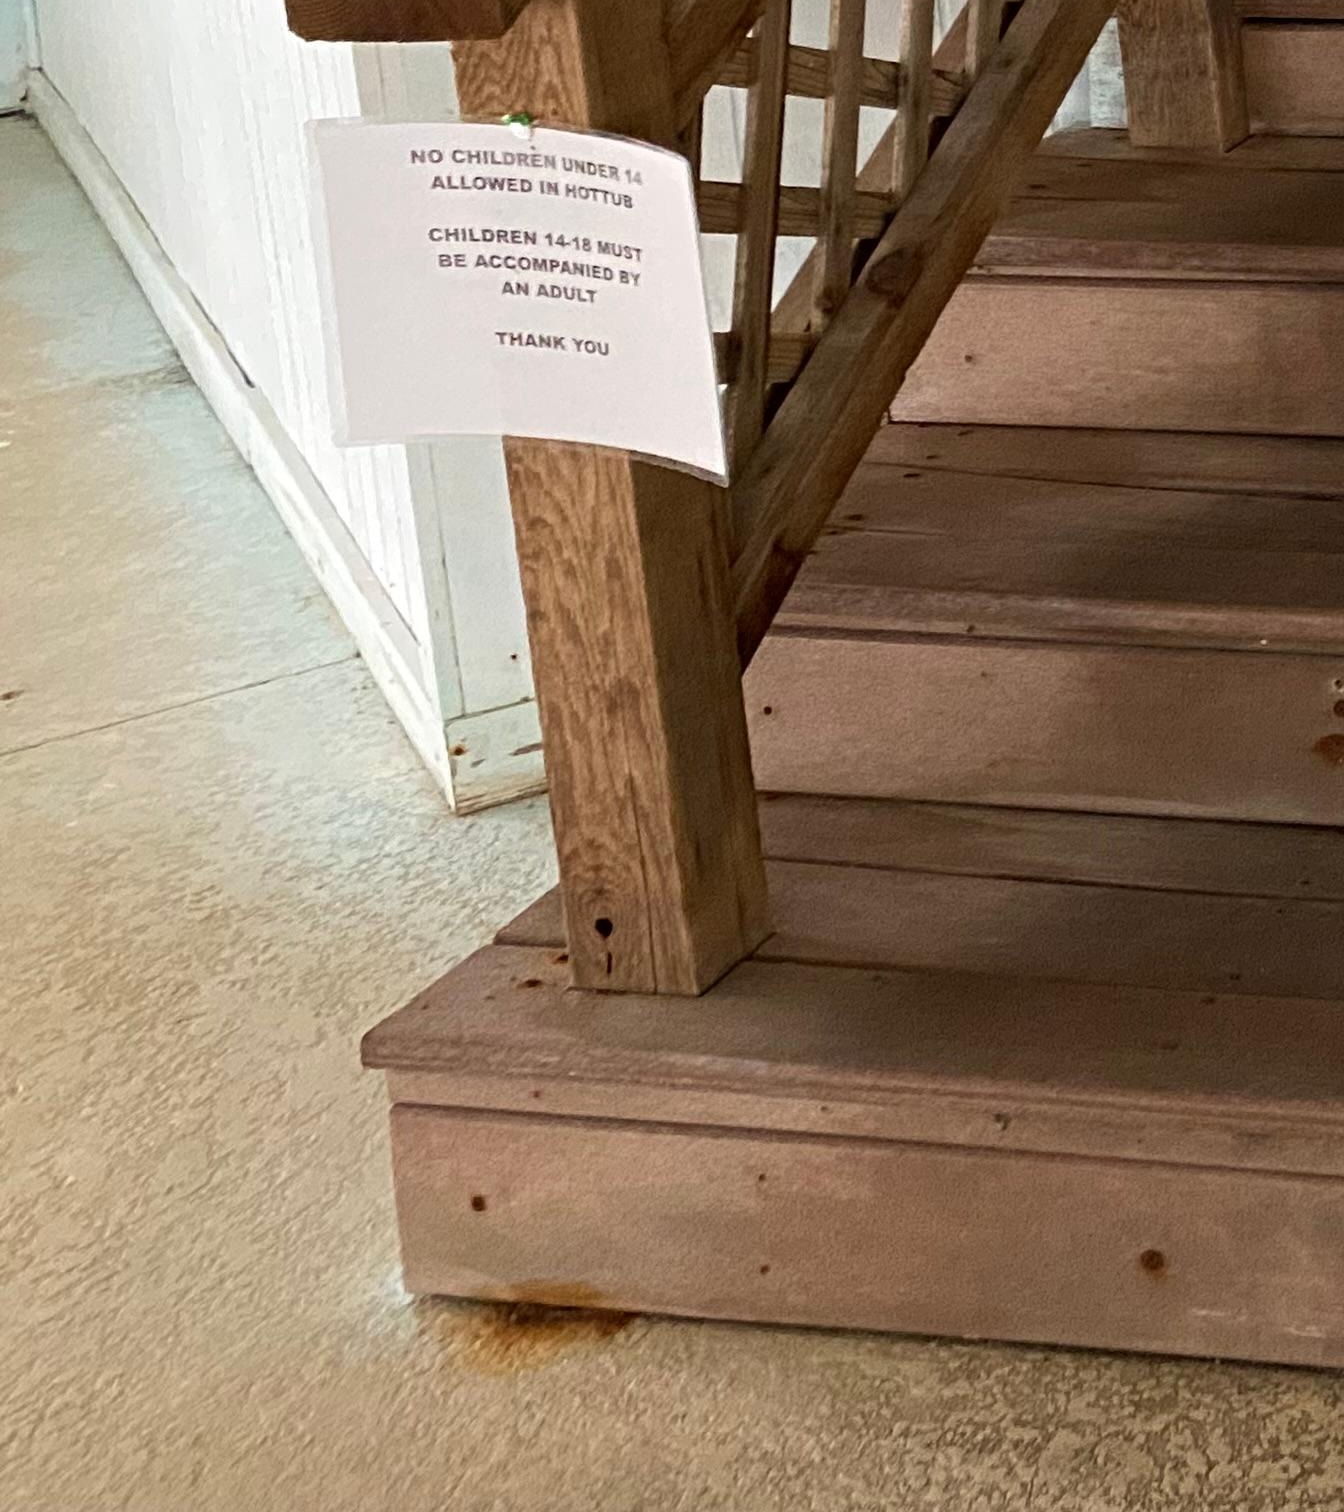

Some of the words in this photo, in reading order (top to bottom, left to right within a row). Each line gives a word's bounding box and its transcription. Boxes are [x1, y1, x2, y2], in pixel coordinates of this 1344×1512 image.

[410, 149, 443, 164] NO
[452, 148, 556, 170] CHILDREN
[562, 158, 619, 181] UNDER
[625, 169, 642, 185] 14
[431, 176, 532, 193] ALLOWED
[540, 181, 559, 195] IN
[565, 184, 634, 208] HOTTUB
[428, 227, 537, 245] CHILDREN
[545, 233, 592, 253] 14-18
[598, 240, 642, 262] MUST
[438, 254, 467, 268] BE
[474, 254, 613, 281] ACCOMPANIED
[620, 270, 641, 286] BY
[502, 281, 529, 296] AN
[536, 285, 597, 303] ADULT
[496, 332, 566, 350] THANK
[572, 338, 610, 356] YOU
